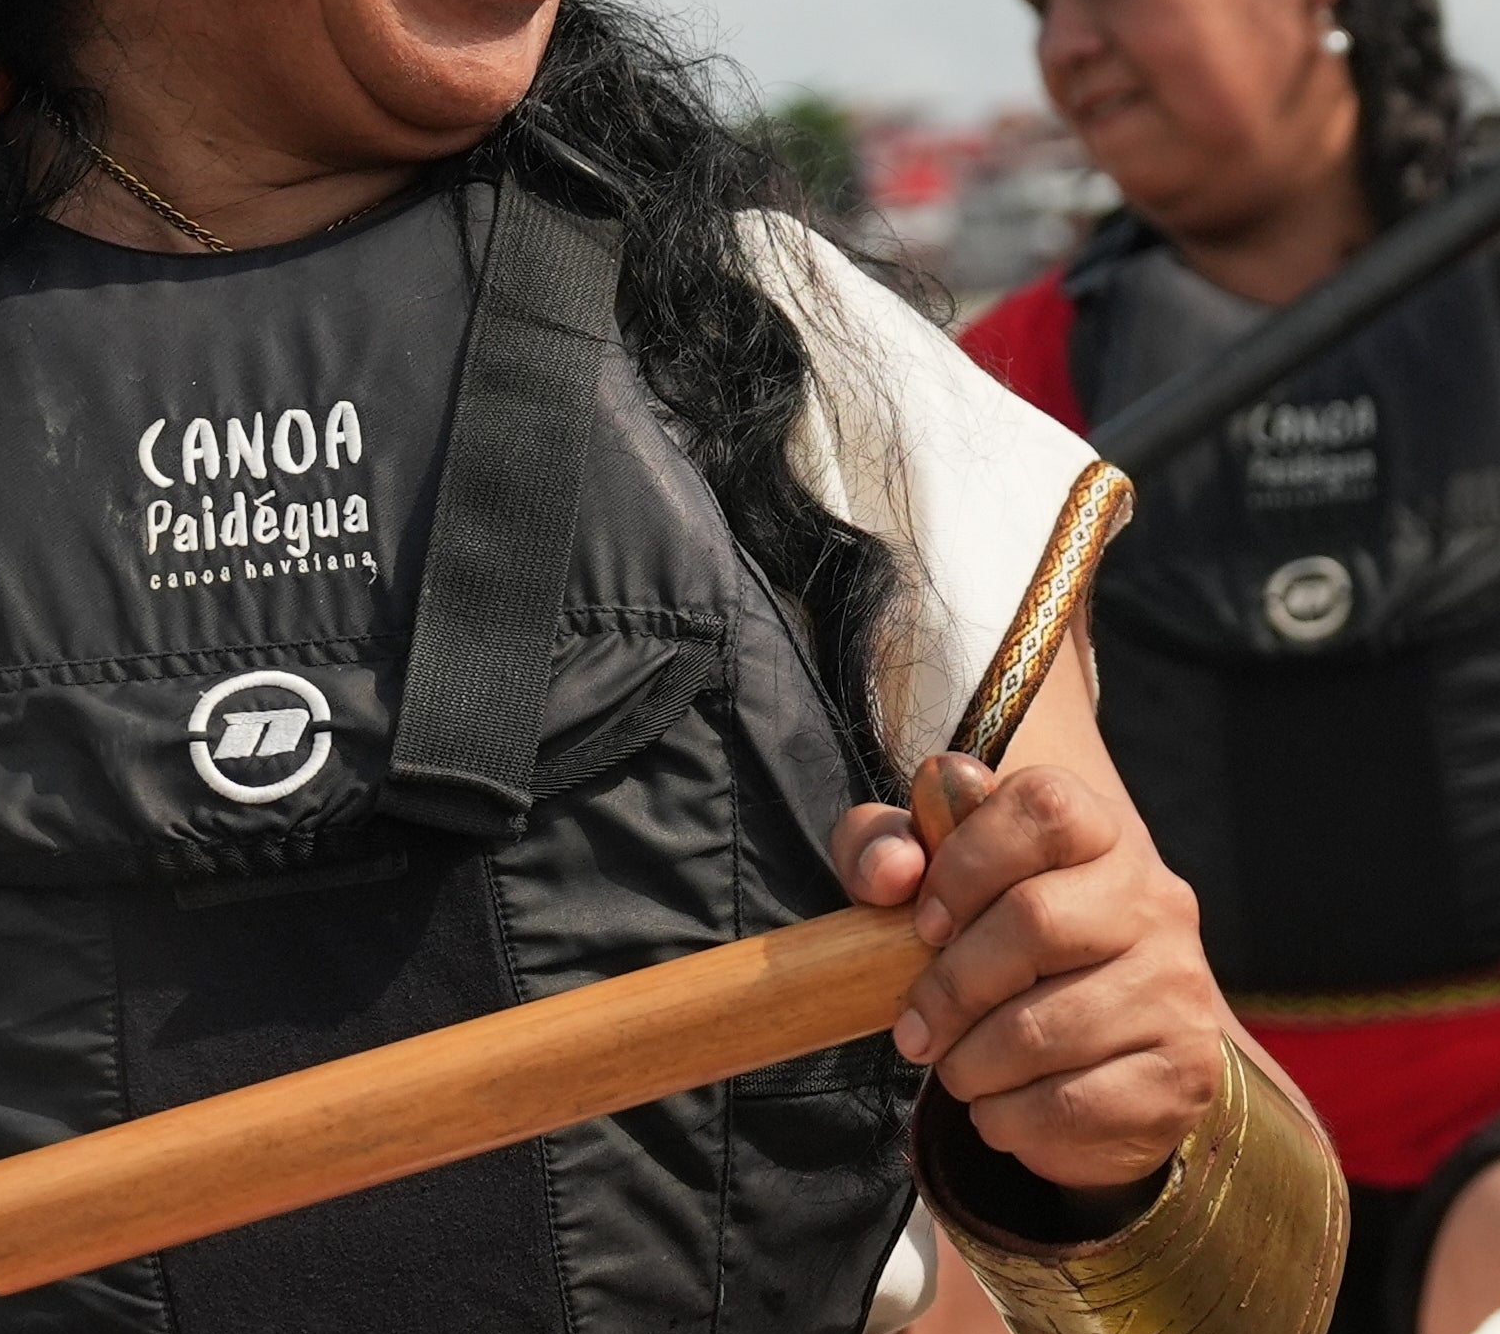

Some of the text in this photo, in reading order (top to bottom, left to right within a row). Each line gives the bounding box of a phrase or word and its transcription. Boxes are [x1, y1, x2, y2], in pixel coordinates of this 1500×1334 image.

[138, 400, 363, 488] CANOA
[147, 489, 370, 557] Paidégua
[149, 565, 233, 590] canoa
